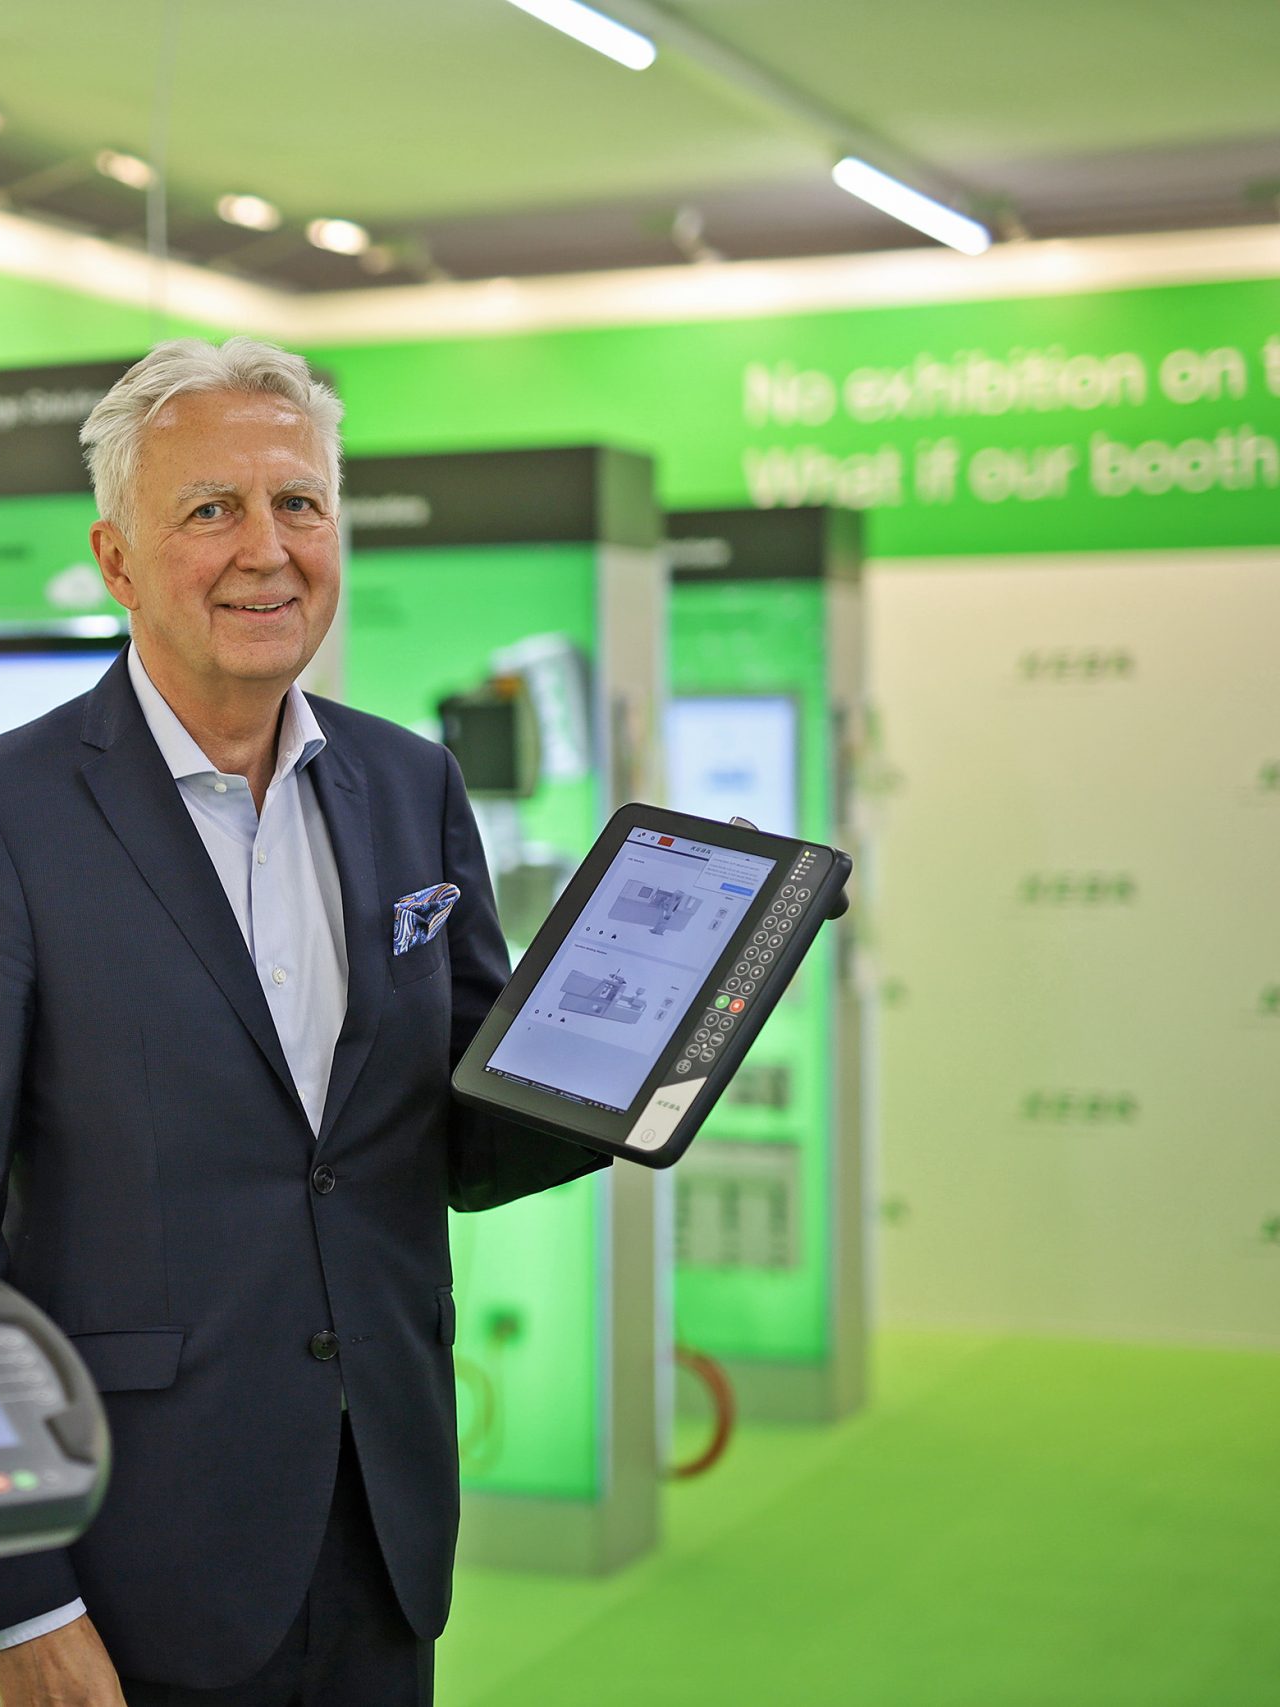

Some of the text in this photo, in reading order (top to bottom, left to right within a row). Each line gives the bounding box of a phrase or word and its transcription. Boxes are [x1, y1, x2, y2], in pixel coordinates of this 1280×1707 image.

[742, 361, 837, 429] No
[844, 344, 1147, 424] exhibition
[1159, 346, 1247, 405] on
[742, 422, 1280, 510] What if our booth
